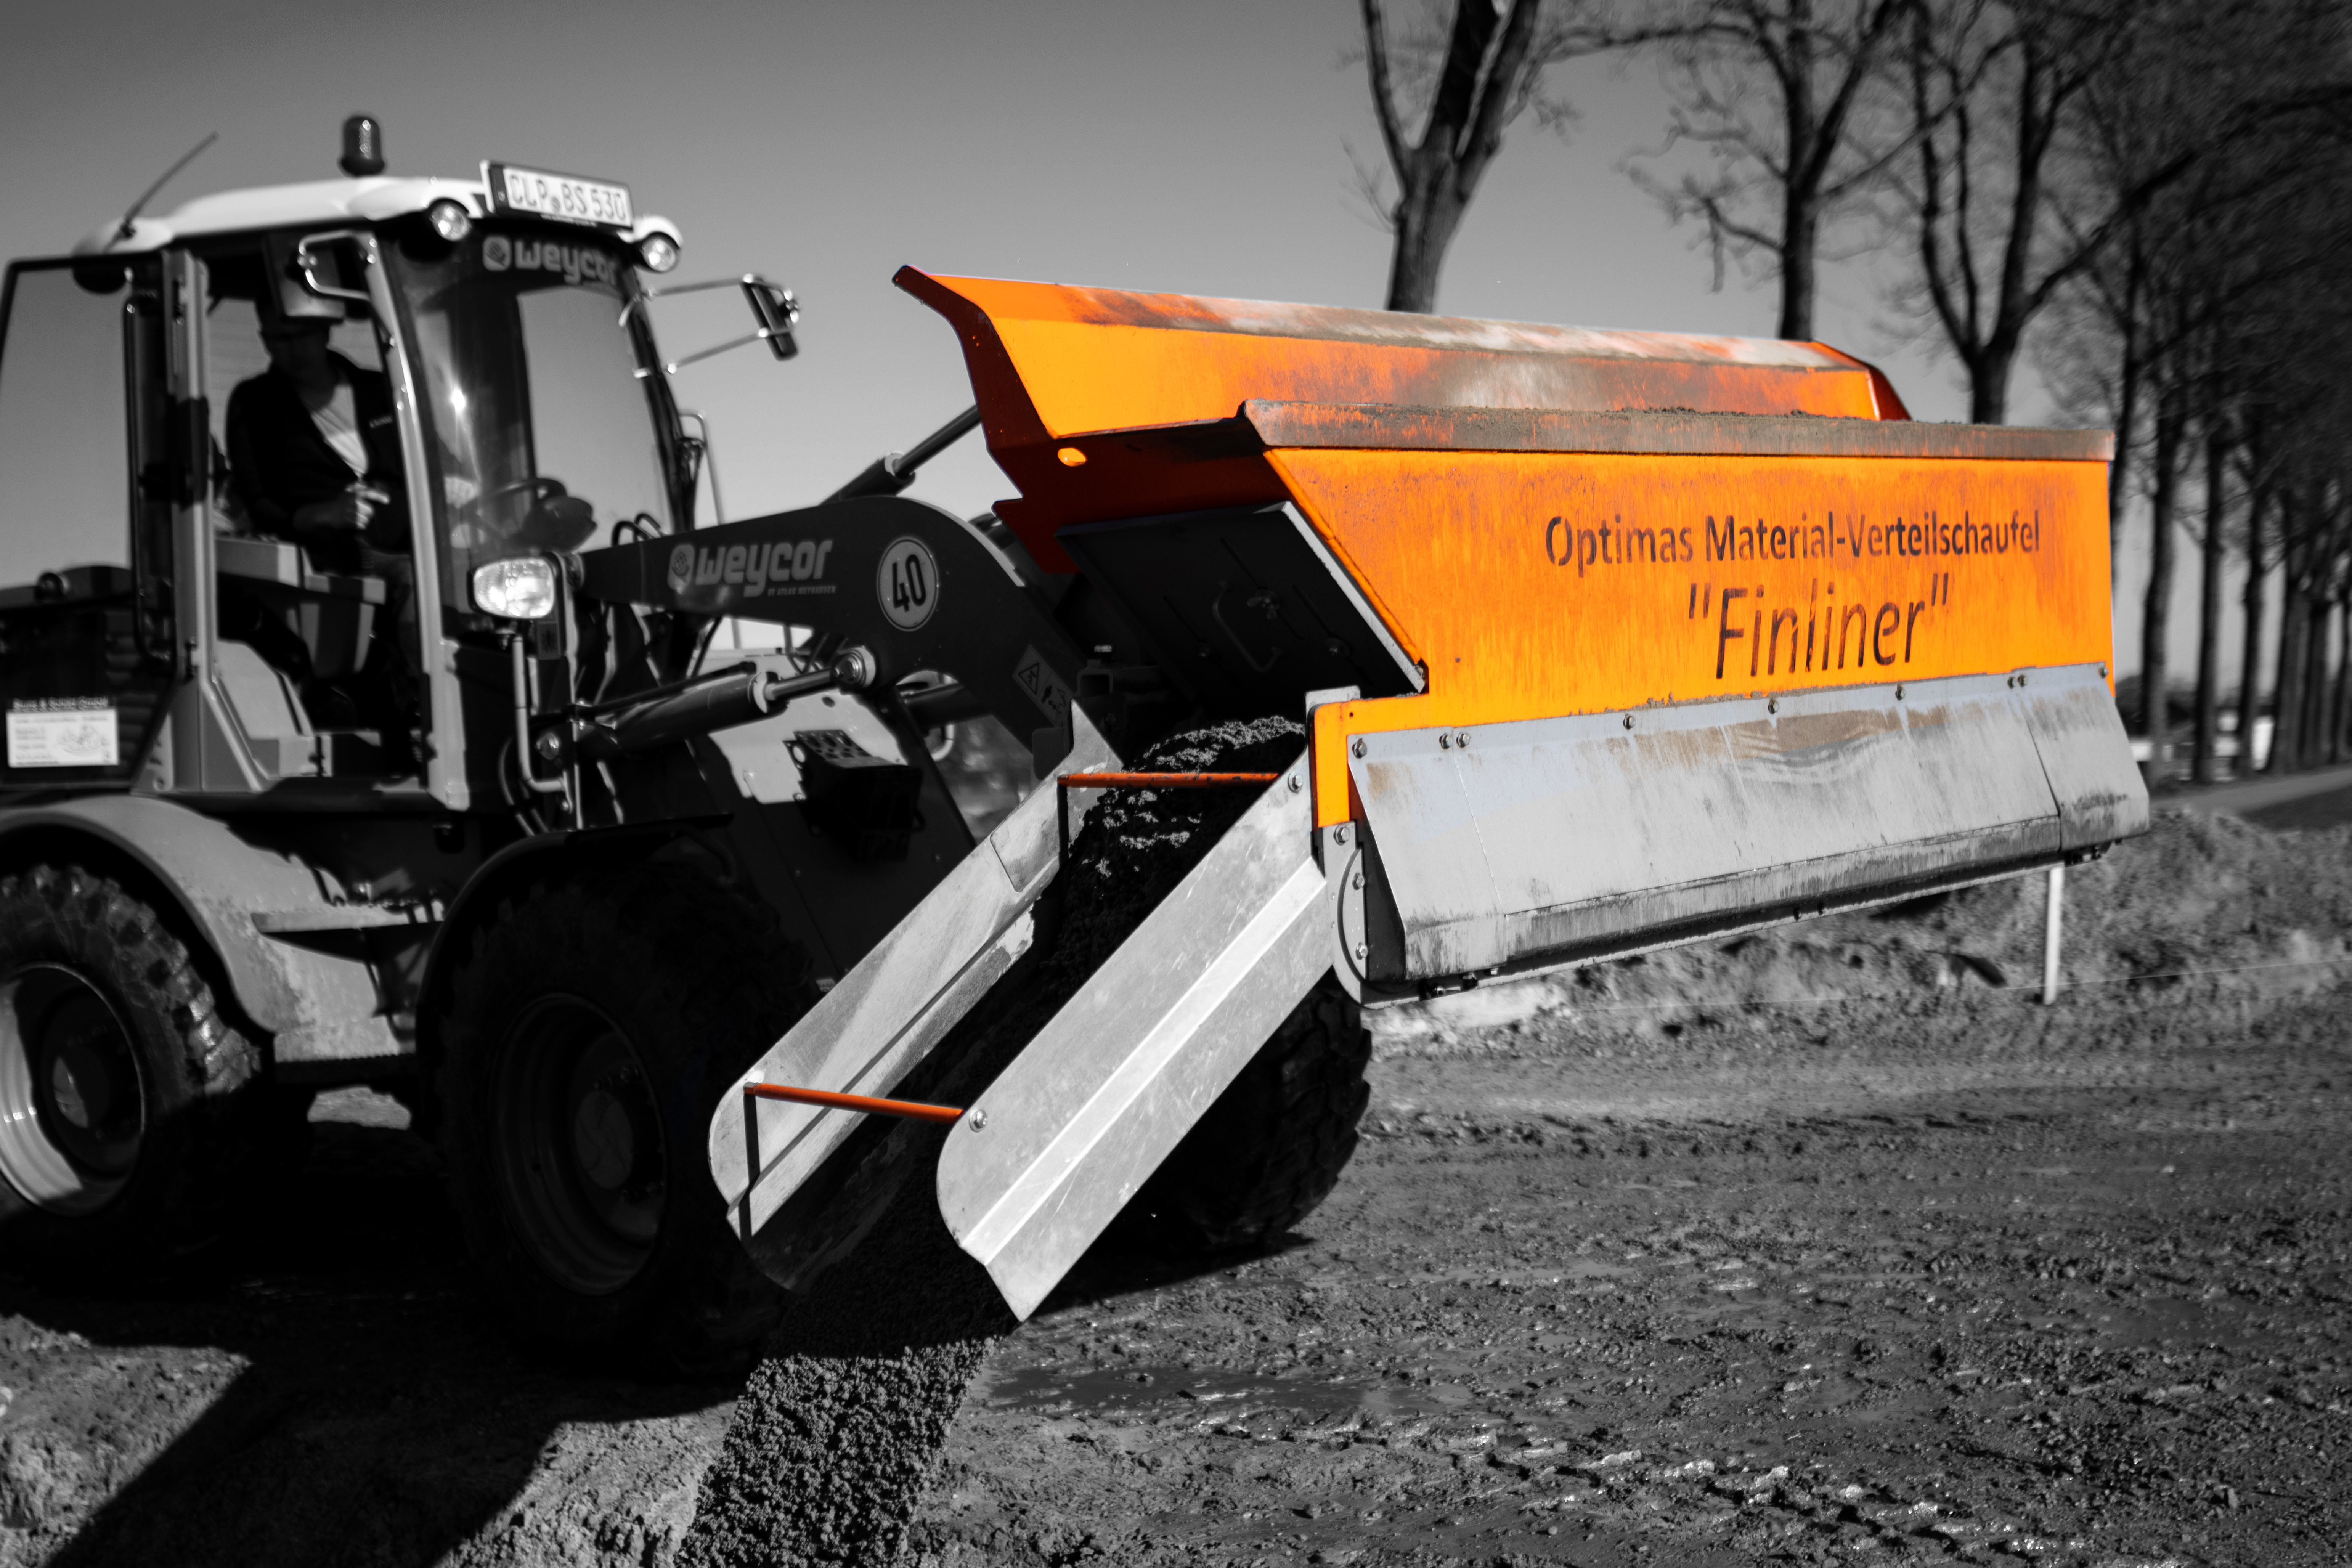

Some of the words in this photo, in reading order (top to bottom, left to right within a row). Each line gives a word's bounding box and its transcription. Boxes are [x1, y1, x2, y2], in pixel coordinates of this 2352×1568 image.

[510, 175, 547, 207] CLP
[560, 183, 586, 214] BS
[590, 188, 626, 220] 530
[514, 240, 616, 284] weycor
[695, 540, 833, 597] weycor
[1545, 513, 1693, 579] Optimas
[1705, 510, 2040, 562] Material-Verteilschaufel
[892, 554, 926, 612] 40
[1688, 572, 1949, 679] "Finliner"
